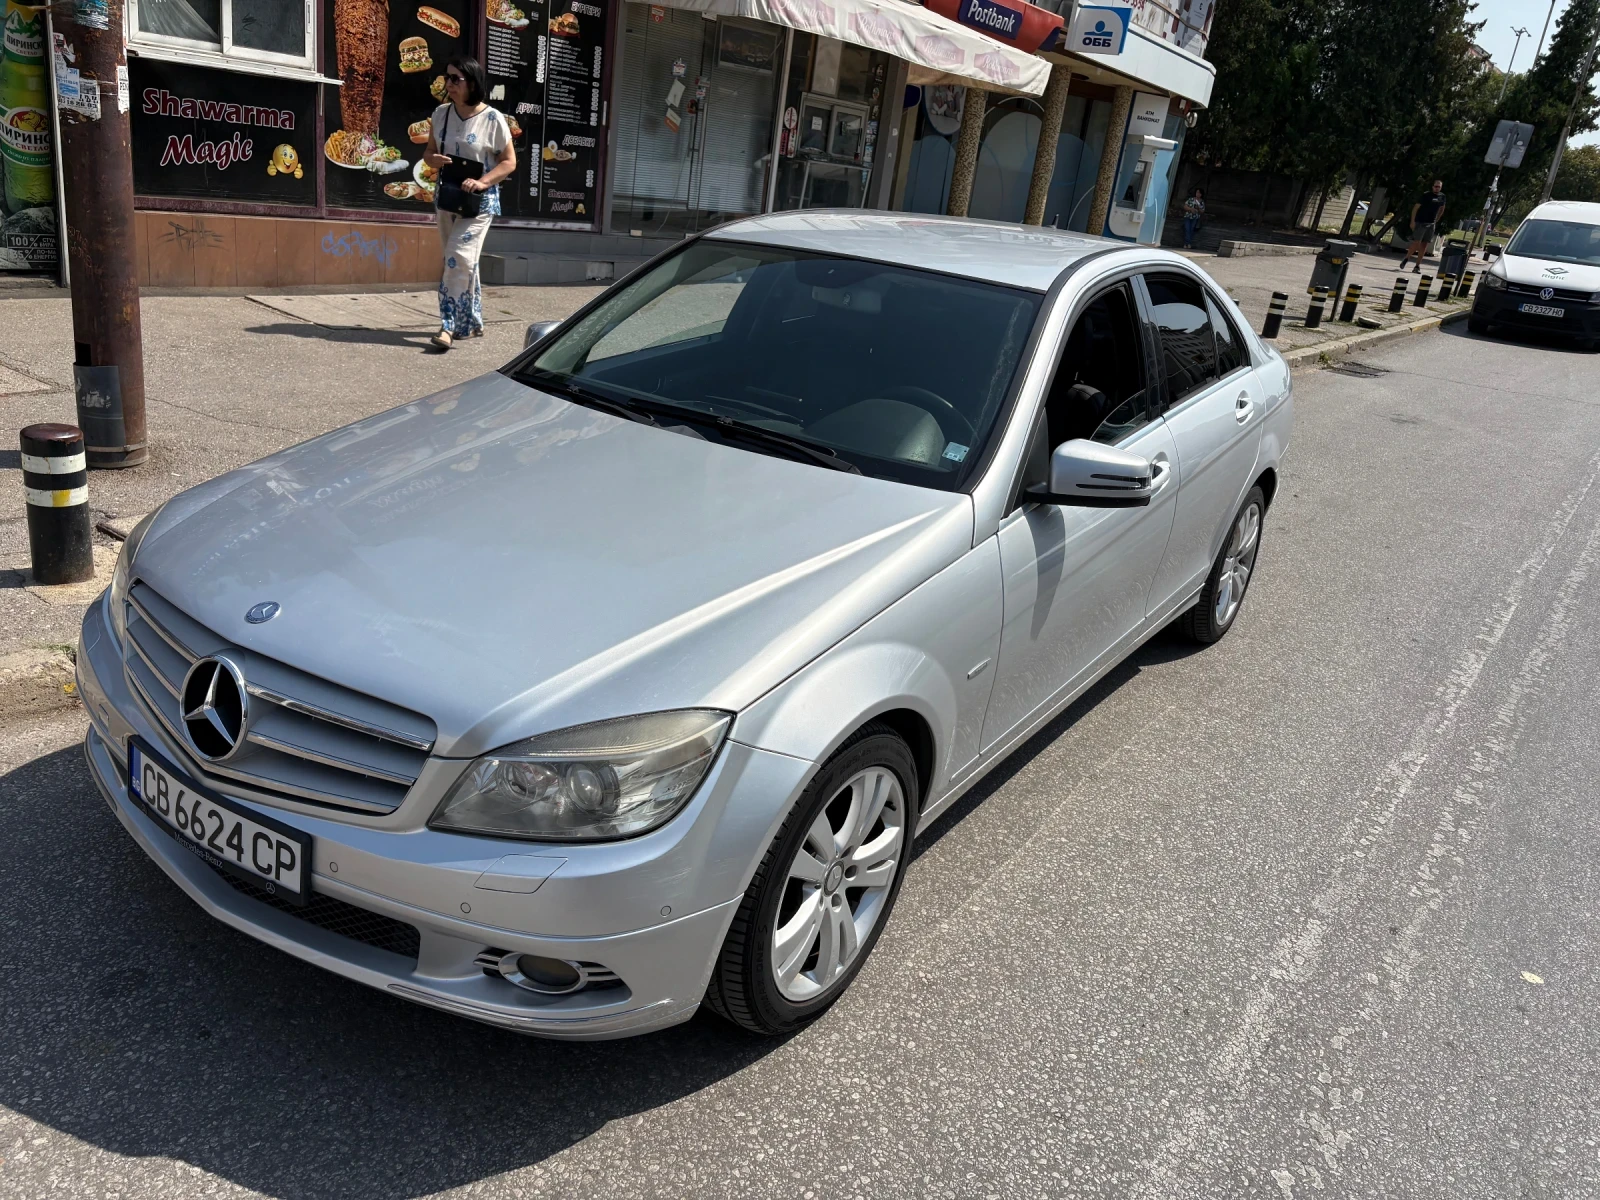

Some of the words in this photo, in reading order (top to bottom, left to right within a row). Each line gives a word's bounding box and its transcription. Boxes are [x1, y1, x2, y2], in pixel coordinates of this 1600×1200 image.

[967, 0, 1016, 33] Postbank
[1082, 37, 1112, 48] ОББ
[143, 87, 295, 130] Shawarma
[160, 132, 253, 170] Magic
[10, 234, 40, 248] 100%
[1534, 306, 1552, 314] 2327
[143, 762, 170, 817] CB
[174, 789, 245, 863] 6624
[252, 831, 296, 881] CP
[174, 831, 223, 869] Mercedes-Benz
